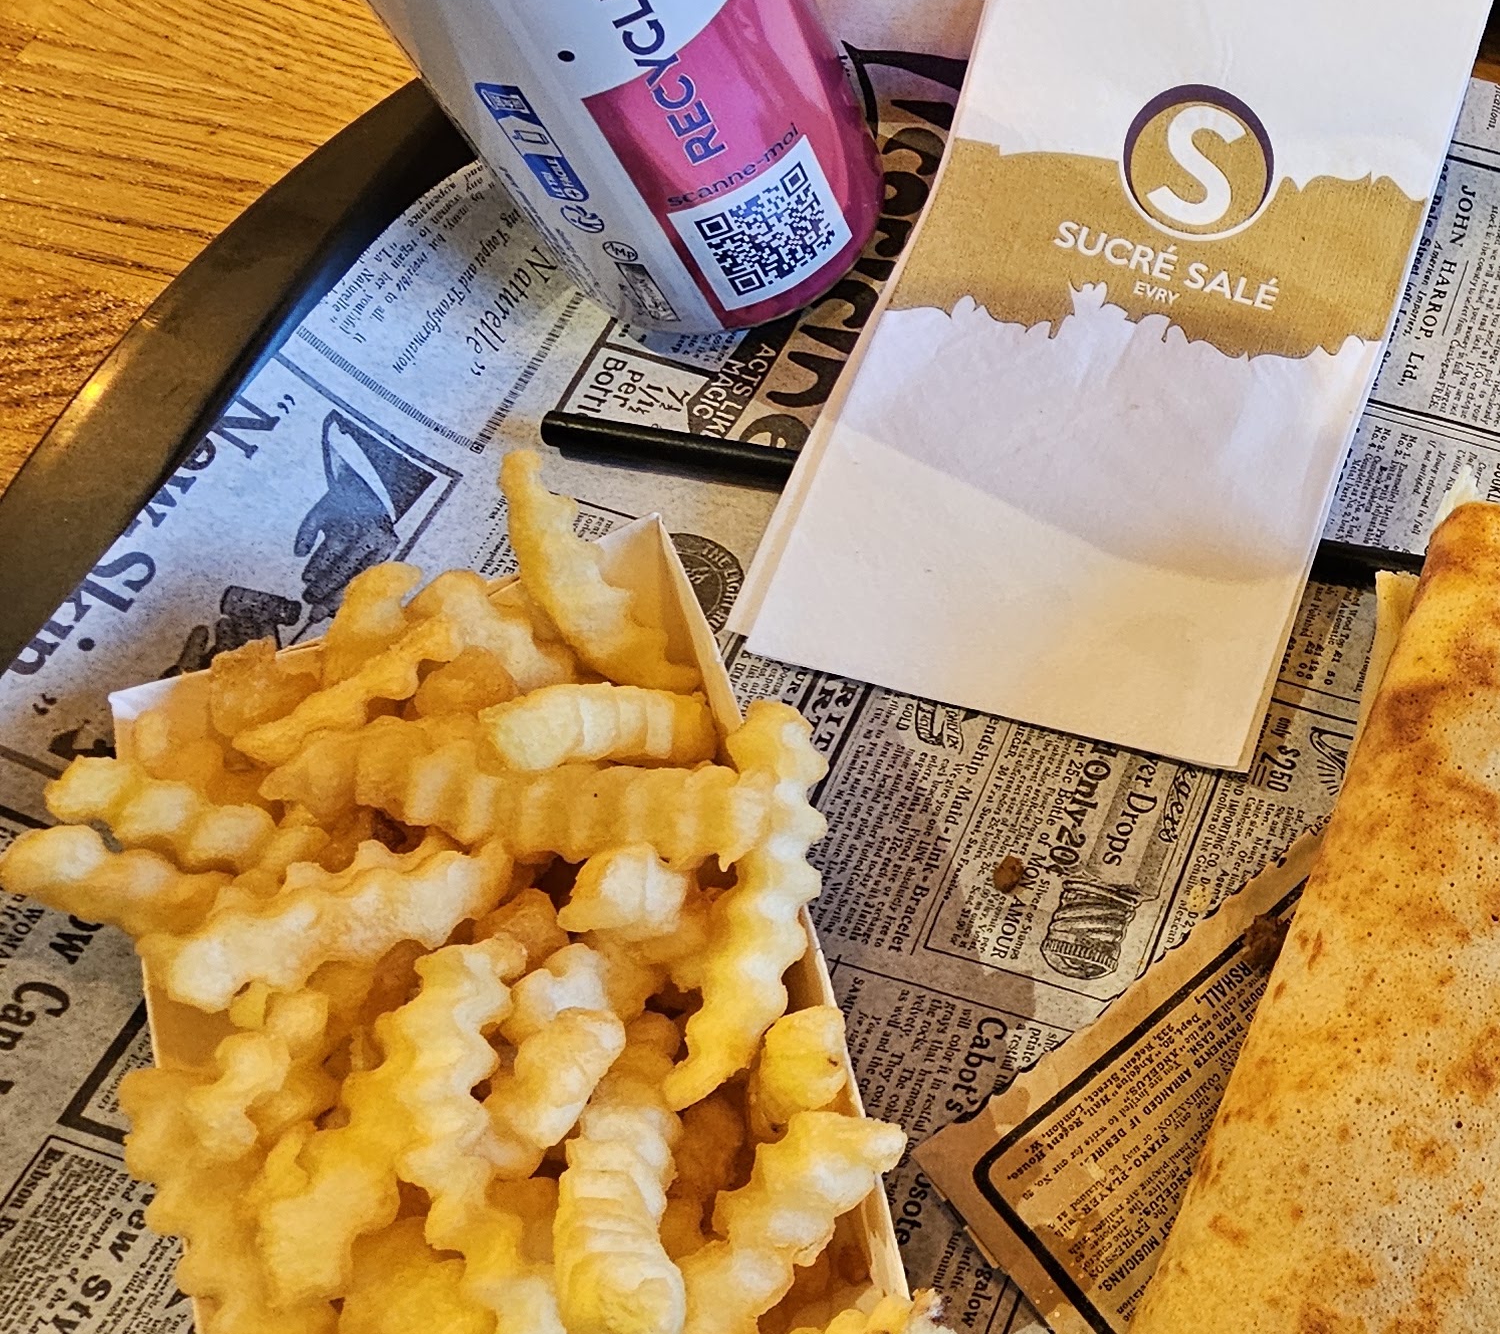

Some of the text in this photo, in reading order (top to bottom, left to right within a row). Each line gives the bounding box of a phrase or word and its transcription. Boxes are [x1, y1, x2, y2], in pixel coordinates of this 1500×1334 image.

[661, 121, 799, 214] scanne-moi
[1145, 105, 1247, 226] S
[1449, 184, 1477, 248] JOHN
[1053, 221, 1280, 311] SUCRÉ SALÉ
[1132, 280, 1181, 306] EVRY
[1414, 259, 1457, 340] HARROP,
[576, 356, 628, 421] Bottl
[692, 355, 746, 420] MAGIC
[731, 343, 777, 398] ACTS
[1101, 786, 1158, 867] Drops
[887, 880, 931, 956] Bracelet
[990, 892, 1027, 959] AMOUR
[944, 1016, 1008, 1119] Cabot's
[1142, 1021, 1246, 1116] PAYMENTS ARRANGED
